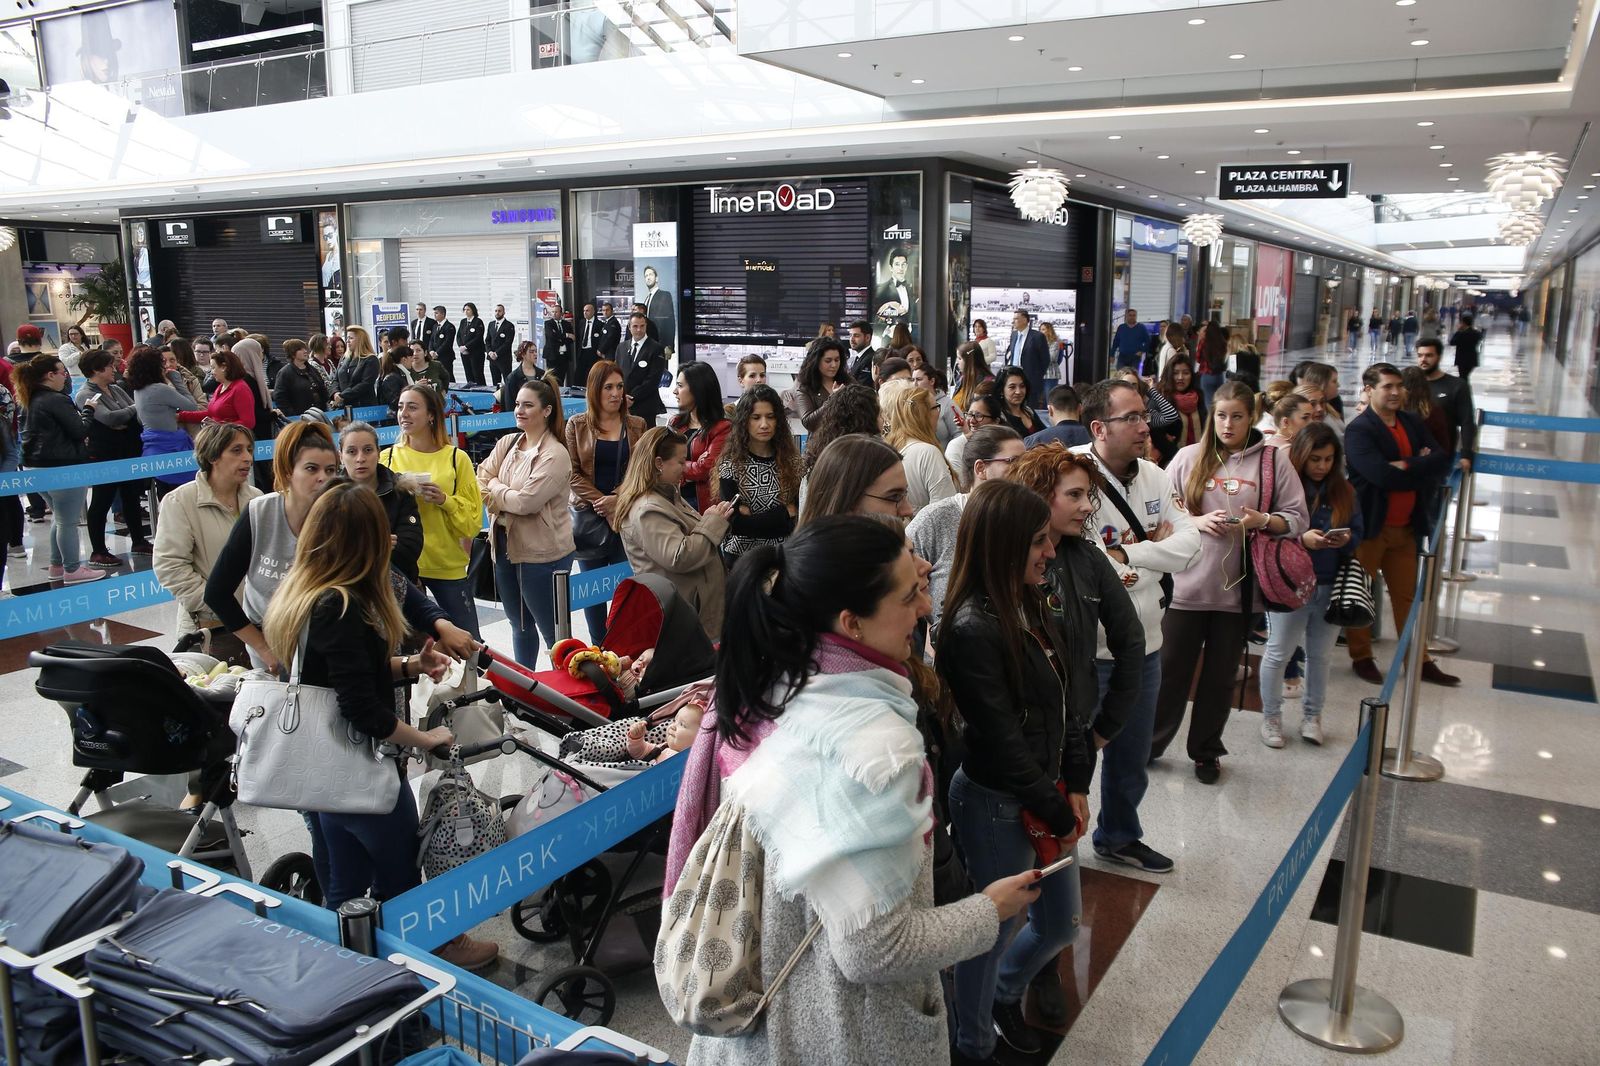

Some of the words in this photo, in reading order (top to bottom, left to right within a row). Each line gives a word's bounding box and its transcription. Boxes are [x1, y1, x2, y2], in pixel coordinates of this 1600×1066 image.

[1229, 172, 1267, 180] PLAZA
[1271, 170, 1327, 180] CENTRAL
[1266, 184, 1319, 192] ALHAMBRA
[491, 208, 556, 224] SAMSUNG
[883, 231, 912, 240] LOTUS
[640, 241, 669, 249] FESTINA
[461, 417, 498, 428] PRIMARK
[1487, 414, 1536, 425] PRIMARK
[131, 458, 193, 474] PRIMARK
[1480, 459, 1547, 474] PRIMARK
[260, 554, 279, 568] YOU
[572, 572, 622, 601] IMARK
[1267, 812, 1322, 919] PRIMARK
[400, 837, 558, 942] PRIMARK
